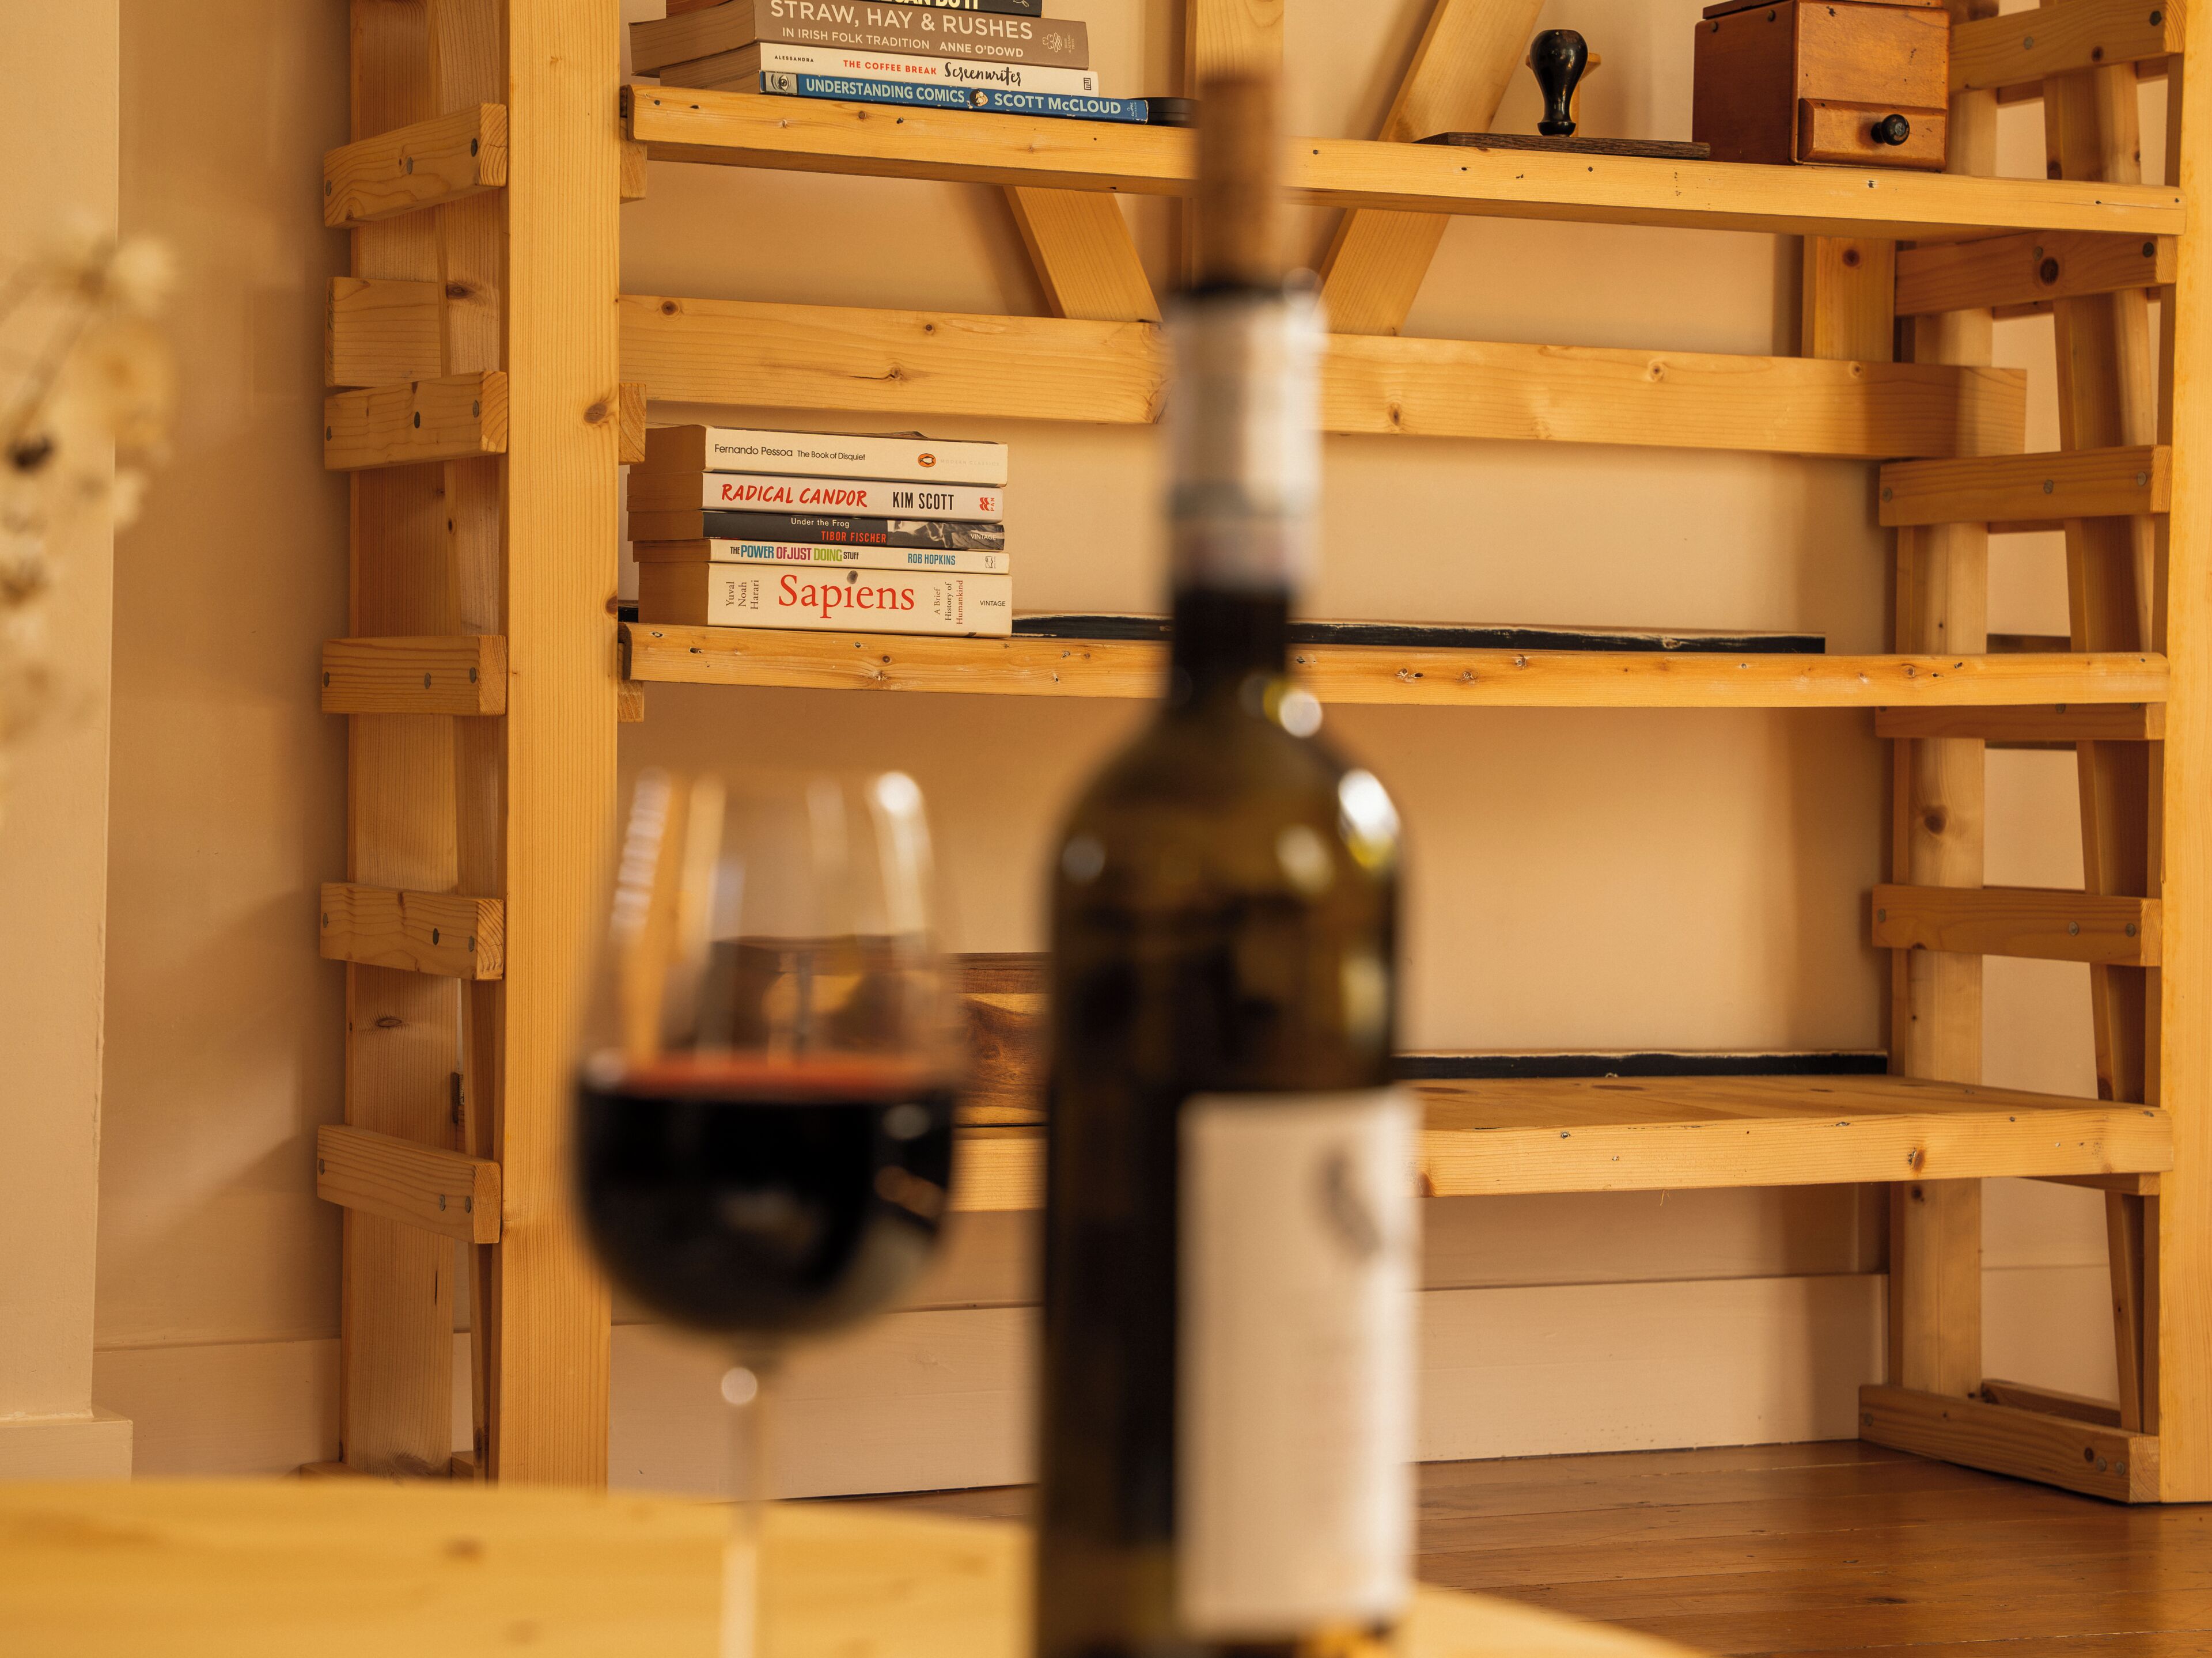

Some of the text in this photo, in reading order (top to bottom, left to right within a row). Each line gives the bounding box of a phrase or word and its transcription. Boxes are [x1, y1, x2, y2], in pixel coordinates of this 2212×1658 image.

[771, 0, 859, 27] STRAW,
[867, 8, 913, 28] HAY
[921, 13, 935, 32] &
[942, 15, 1033, 40] RUSHES
[782, 27, 930, 50] IN IRISH FOLK TRADITION
[940, 41, 1024, 58] ANNE O'DOWD
[774, 55, 815, 63] ALESSANDRA
[843, 60, 1021, 86] THE COFFEE BREAK Screenwriter
[806, 78, 913, 99] UNDERSTANDING
[916, 87, 965, 103] COMICS
[994, 93, 1044, 109] SCOTT
[1048, 97, 1121, 114] McCLOUD
[715, 444, 759, 455] Fernando
[761, 446, 793, 457] Pessoa
[838, 453, 866, 461] Disquiet
[721, 484, 954, 510] RADICAL CANDOR KIM SCOTT
[821, 530, 887, 543] TIBOR FISCHER
[832, 519, 850, 529] Frog
[730, 547, 740, 555] THE
[741, 545, 774, 559] POWER
[814, 548, 842, 561] DOING
[843, 552, 859, 560] STUFF
[908, 553, 956, 566] ROB HOPKINS
[726, 581, 734, 606] Yuval
[738, 582, 747, 607] Noah
[751, 580, 759, 610] Harari
[779, 572, 915, 619] Sapiens
[945, 593, 953, 621] History
